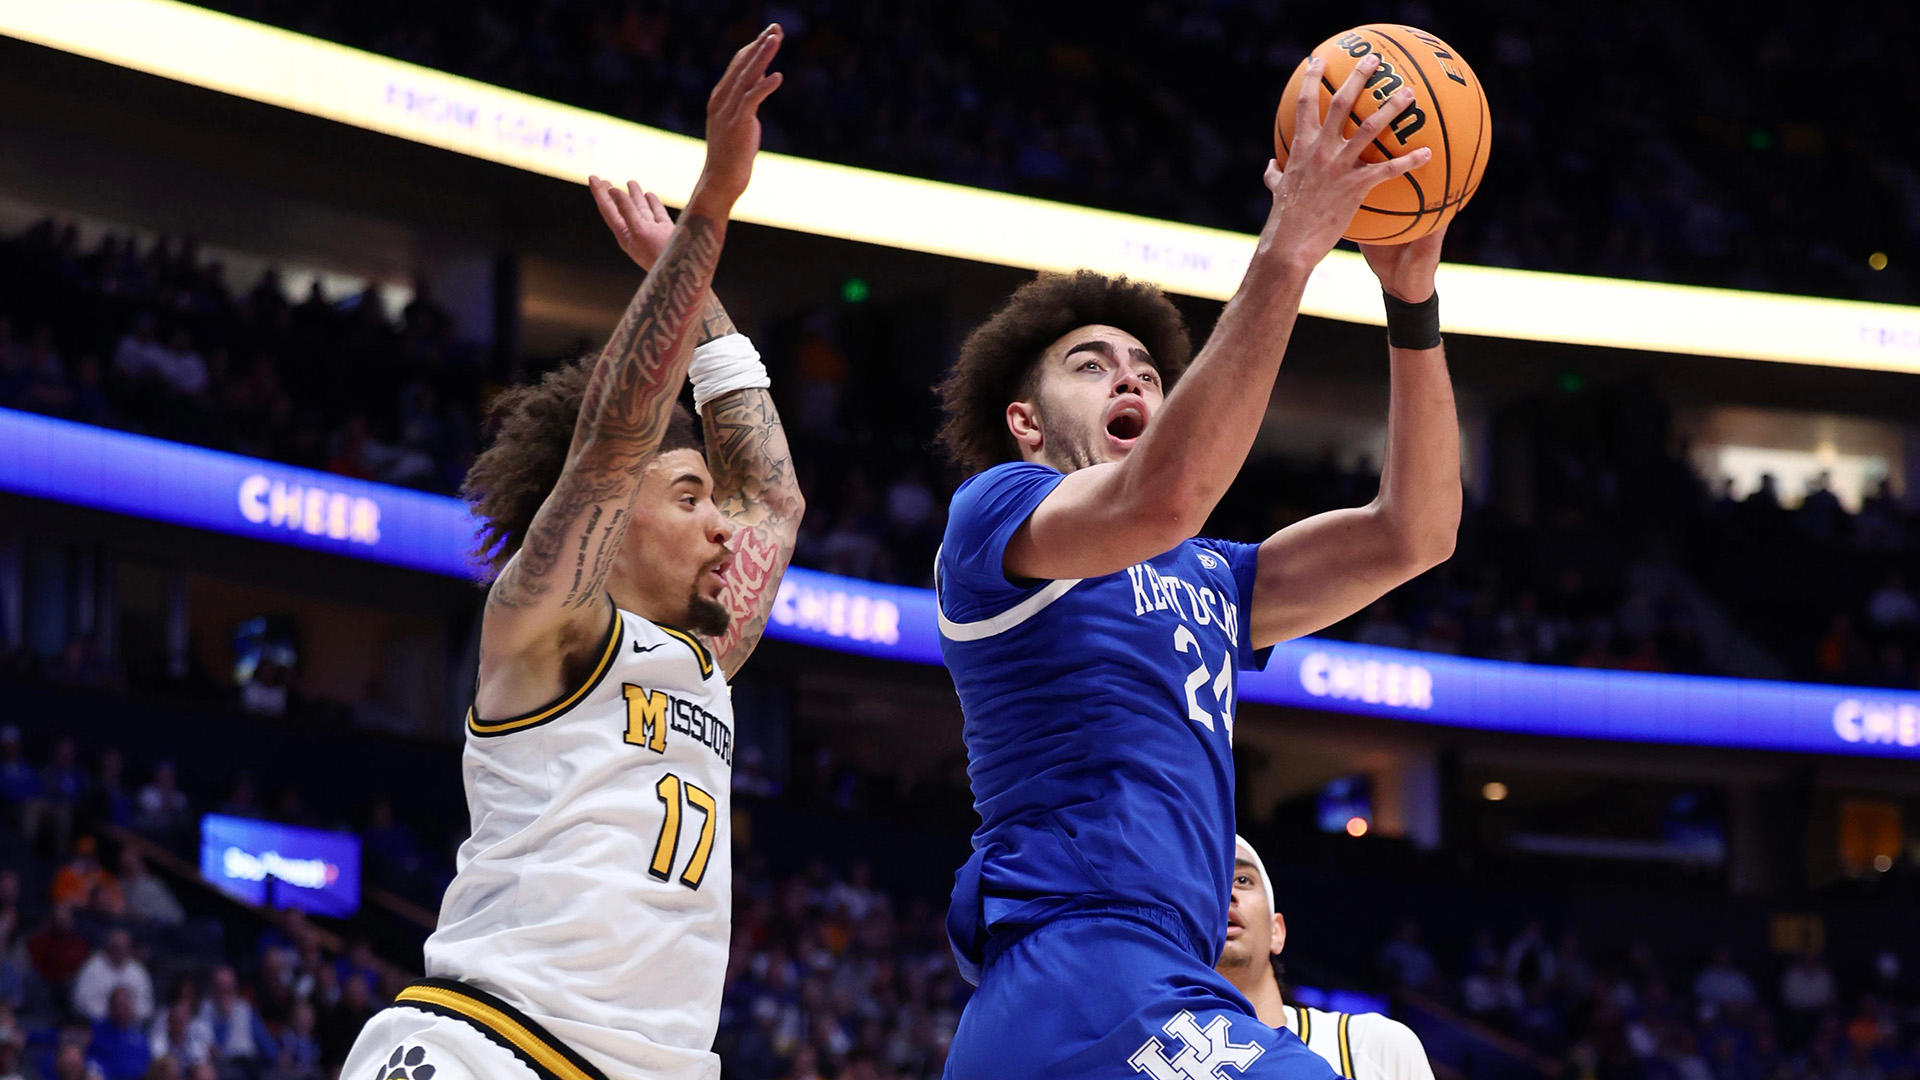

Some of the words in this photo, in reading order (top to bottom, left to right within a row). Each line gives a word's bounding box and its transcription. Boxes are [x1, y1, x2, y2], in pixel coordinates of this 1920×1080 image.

[239, 474, 381, 545] CHEER
[771, 581, 899, 645] CHEER
[1173, 624, 1234, 751] 24
[1300, 652, 1433, 710] CHEER
[1833, 699, 1920, 747] CHE
[648, 772, 717, 891] 17
